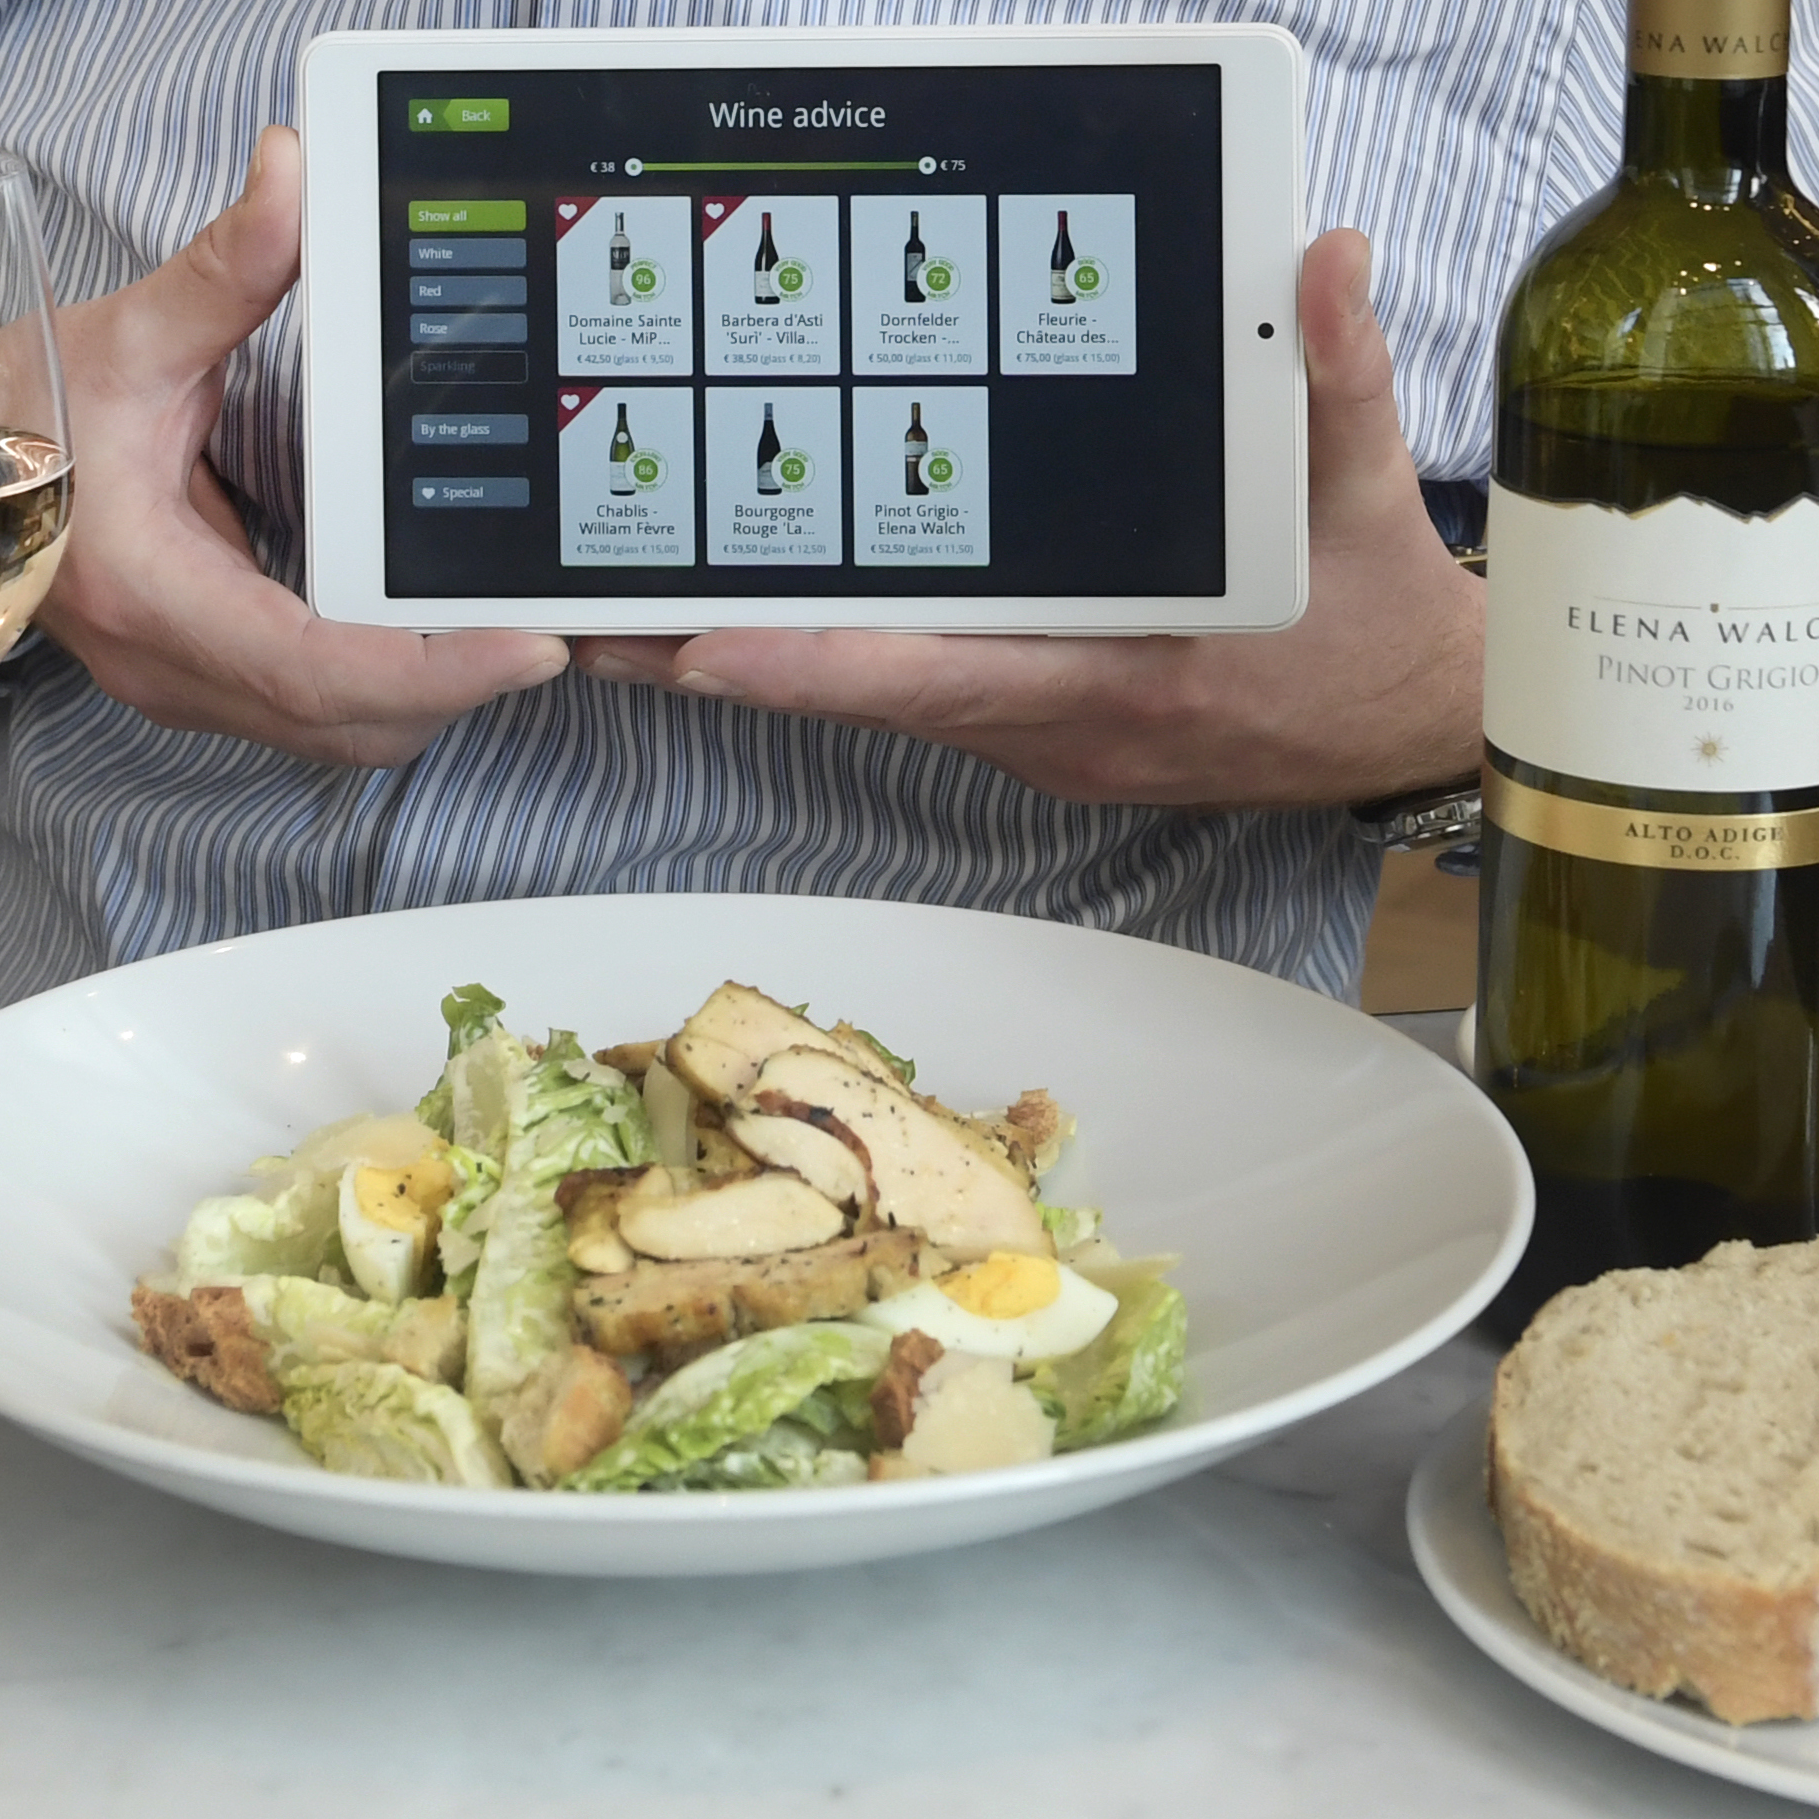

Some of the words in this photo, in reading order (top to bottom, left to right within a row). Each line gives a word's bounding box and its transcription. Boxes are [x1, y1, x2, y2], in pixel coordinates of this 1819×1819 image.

[1635, 30, 1685, 53] ENA
[462, 110, 491, 121] Back
[709, 101, 783, 128] Wine
[793, 100, 886, 128] advice
[590, 162, 597, 172] €
[601, 162, 615, 172] 38
[941, 161, 948, 171] €
[951, 160, 966, 171] 75
[418, 211, 449, 221] Show
[453, 210, 467, 221] all
[419, 248, 453, 259] White
[636, 274, 651, 284] 96
[783, 274, 798, 284] 75
[931, 273, 945, 283] 72
[1080, 273, 1094, 283] 65
[419, 285, 441, 296] Red
[569, 315, 632, 327] Domaine
[639, 315, 681, 327] Sainte
[722, 314, 778, 326] Barbera
[785, 314, 823, 326] d'Asti
[881, 314, 959, 326] Dornfelder
[1039, 313, 1086, 325] Fleurie
[419, 323, 448, 334] Rose
[580, 333, 616, 344] Lucie
[880, 331, 936, 343] Trocken
[1017, 331, 1075, 343] Château
[420, 361, 475, 373] Sparkling
[421, 424, 436, 438] By
[439, 424, 457, 434] the
[460, 423, 490, 438] glass
[639, 465, 653, 475] 86
[786, 465, 800, 474] 75
[933, 465, 947, 474] 65
[443, 486, 483, 501] Special
[597, 505, 648, 517] Chablis
[735, 505, 814, 520] Bourgogne
[875, 505, 911, 517] Pinot
[917, 505, 959, 520] Grigio
[579, 522, 630, 534] William
[637, 522, 675, 534] Fèvre
[733, 522, 777, 538] Rouge
[878, 522, 916, 534] Elena
[921, 522, 965, 534] Walch
[1568, 606, 1690, 643] ELENA
[1598, 654, 1696, 689] PINOT
[1707, 664, 1819, 690] GRIGIO
[1684, 696, 1734, 712] 2016
[1625, 823, 1692, 841] ALTO
[1706, 827, 1784, 843] ADIGE
[1671, 845, 1740, 860] D.O.C.
